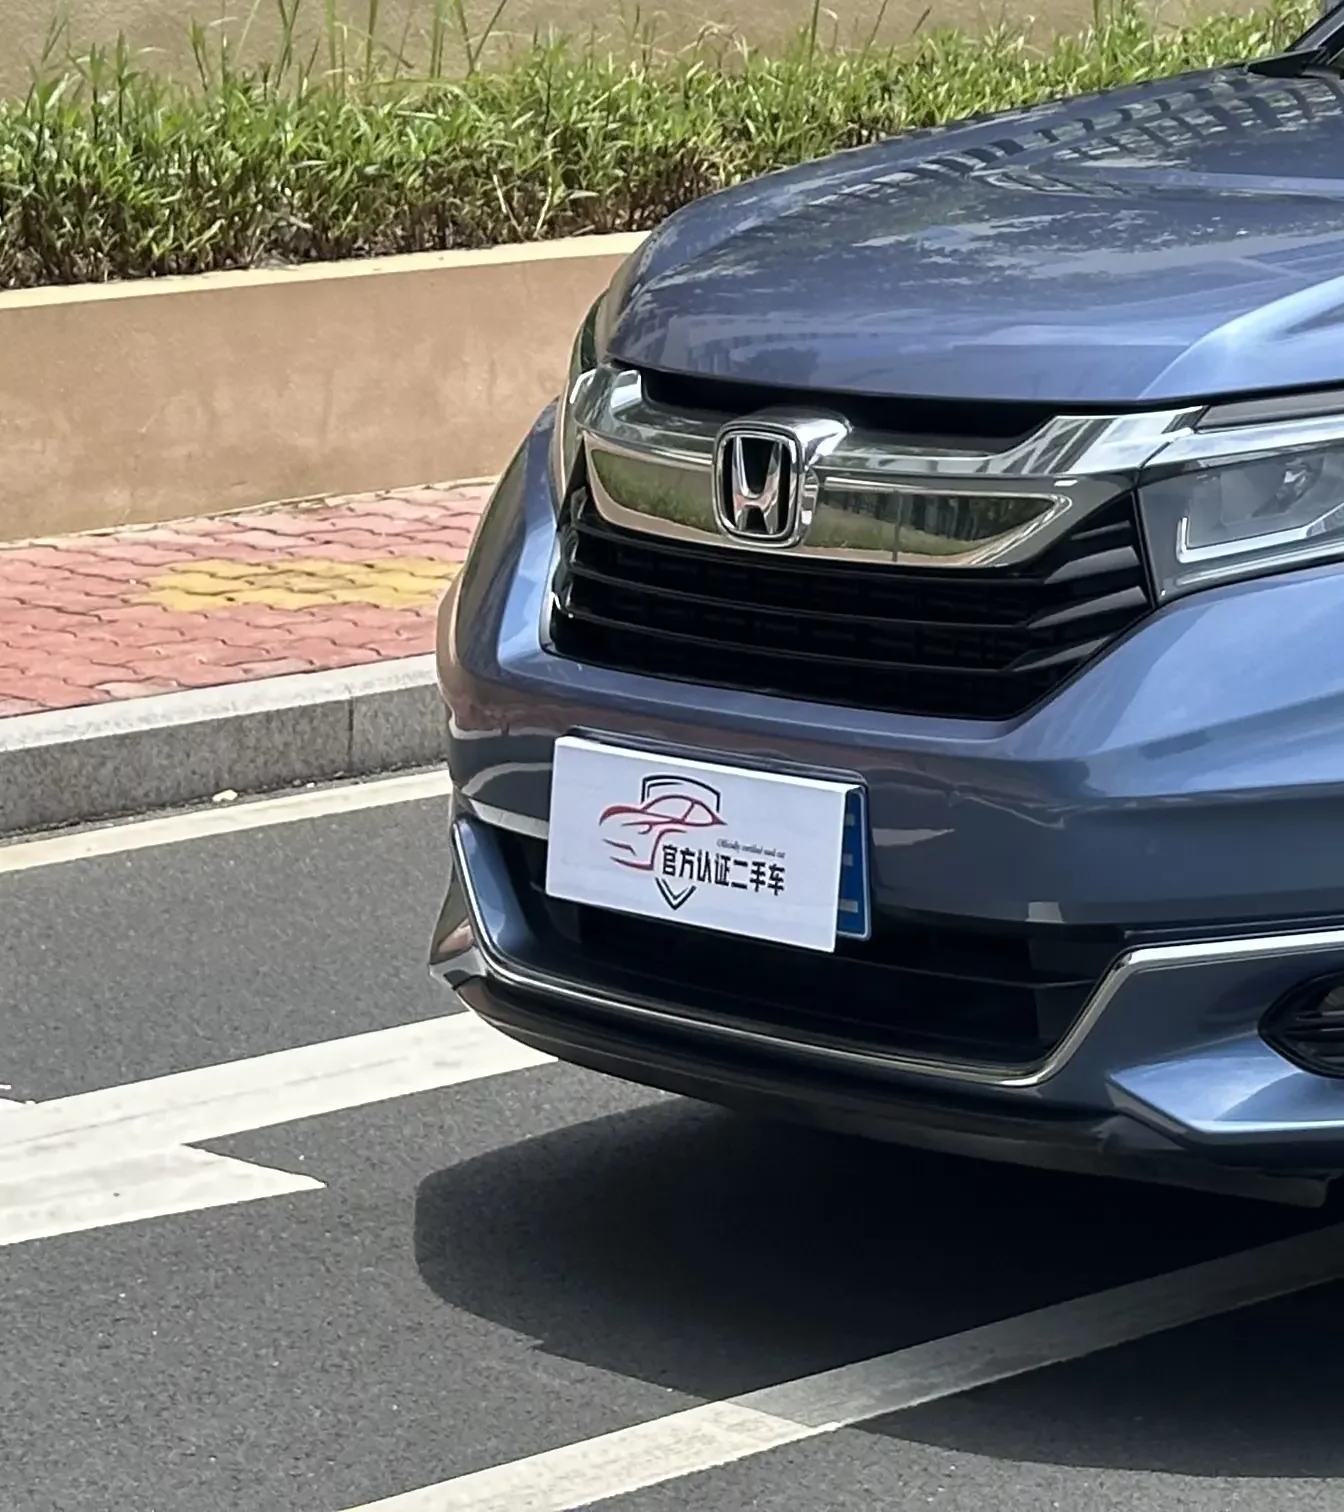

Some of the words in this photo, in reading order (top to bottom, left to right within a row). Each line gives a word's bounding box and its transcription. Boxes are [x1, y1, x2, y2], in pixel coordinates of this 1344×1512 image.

[662, 844, 785, 896] 官方认证二手车
